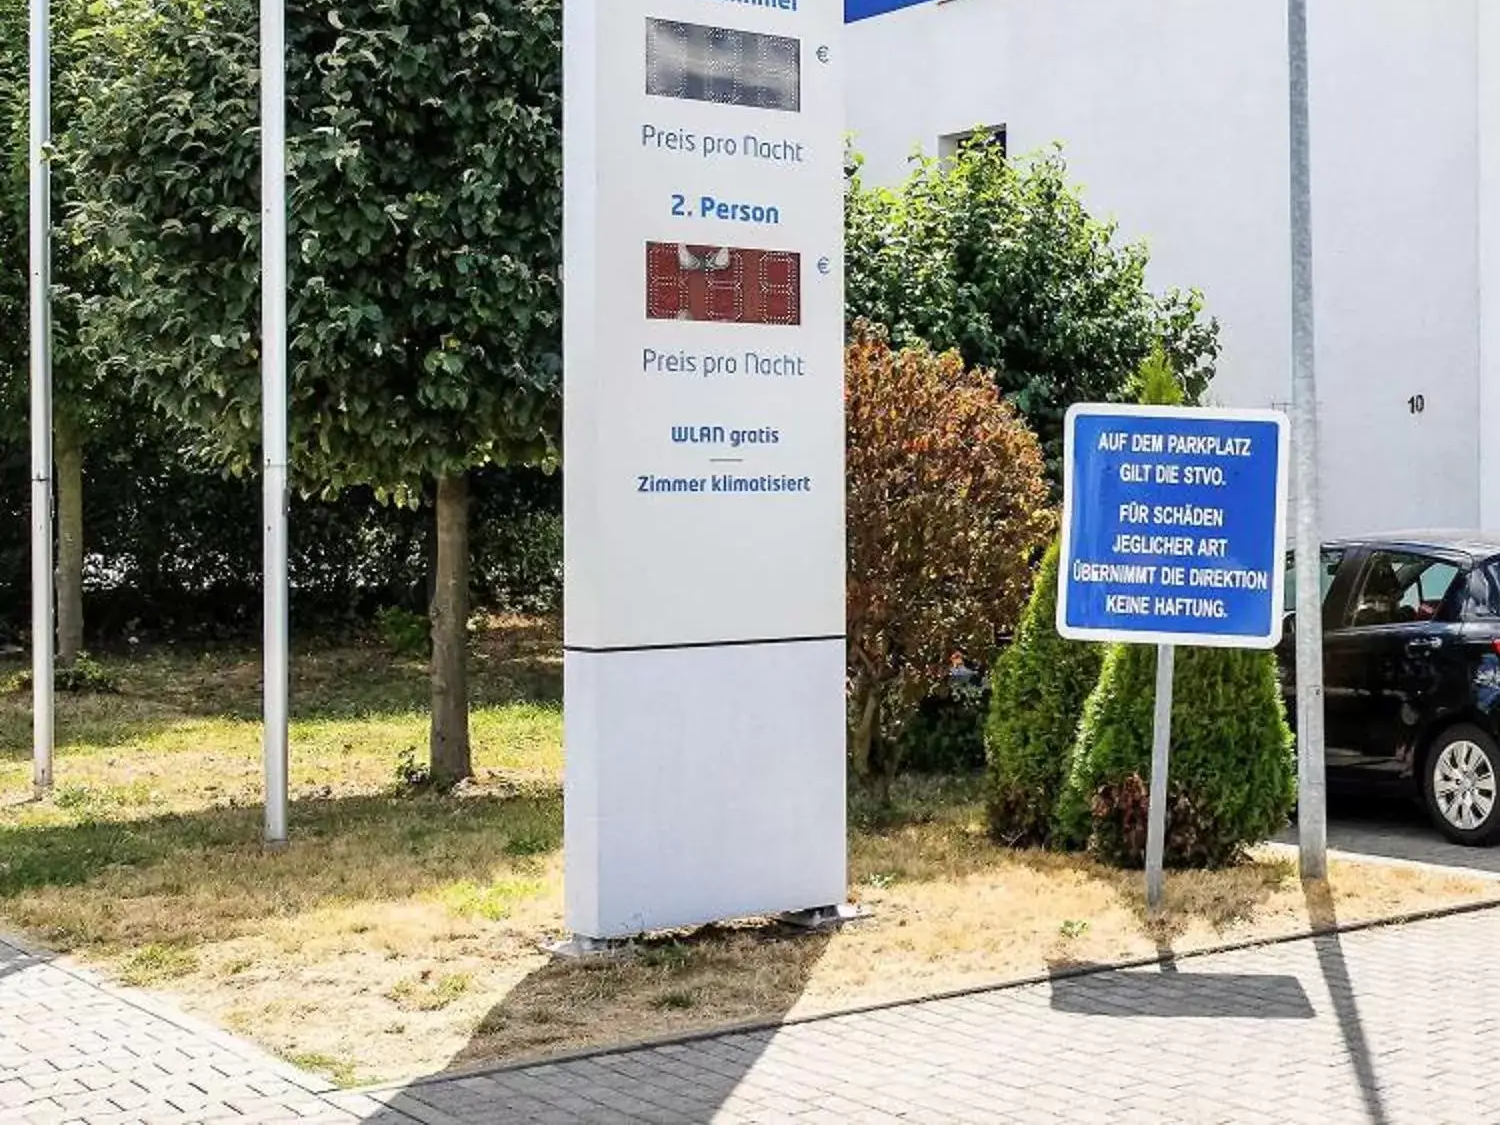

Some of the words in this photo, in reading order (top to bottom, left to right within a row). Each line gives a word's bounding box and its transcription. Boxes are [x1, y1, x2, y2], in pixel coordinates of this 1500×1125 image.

[816, 45, 832, 64] €
[642, 124, 696, 153] Preis
[703, 136, 737, 158] pro
[743, 136, 803, 162] Nacht
[671, 194, 693, 217] 2.
[700, 196, 779, 224] Person
[816, 256, 831, 275] €
[642, 348, 697, 373] Preis
[703, 355, 737, 377] pro
[745, 351, 805, 377] Nacht
[1407, 394, 1425, 414] 10
[671, 425, 725, 444] WLAN
[730, 426, 779, 447] gratis
[1097, 432, 1129, 451] AUF
[1131, 434, 1163, 453] DEM
[1167, 435, 1252, 456] PARKPLATZ
[637, 474, 706, 492] Zimmer
[711, 475, 812, 492] klimatisiert
[1119, 463, 1152, 483] GILT
[1155, 464, 1180, 484] DIE
[1183, 466, 1227, 486] STVO.
[1119, 501, 1149, 524] FÜR
[1153, 504, 1224, 527] SCHÄDEN
[1111, 534, 1194, 556] JEGLICHER
[1198, 538, 1229, 557] ART
[1073, 558, 1157, 585] ÜBERNIMMT
[1161, 567, 1185, 586] DIE
[1189, 569, 1268, 590] DIREKTION
[1105, 595, 1150, 615] KEINE
[1153, 598, 1228, 619] HAFTUNG.
